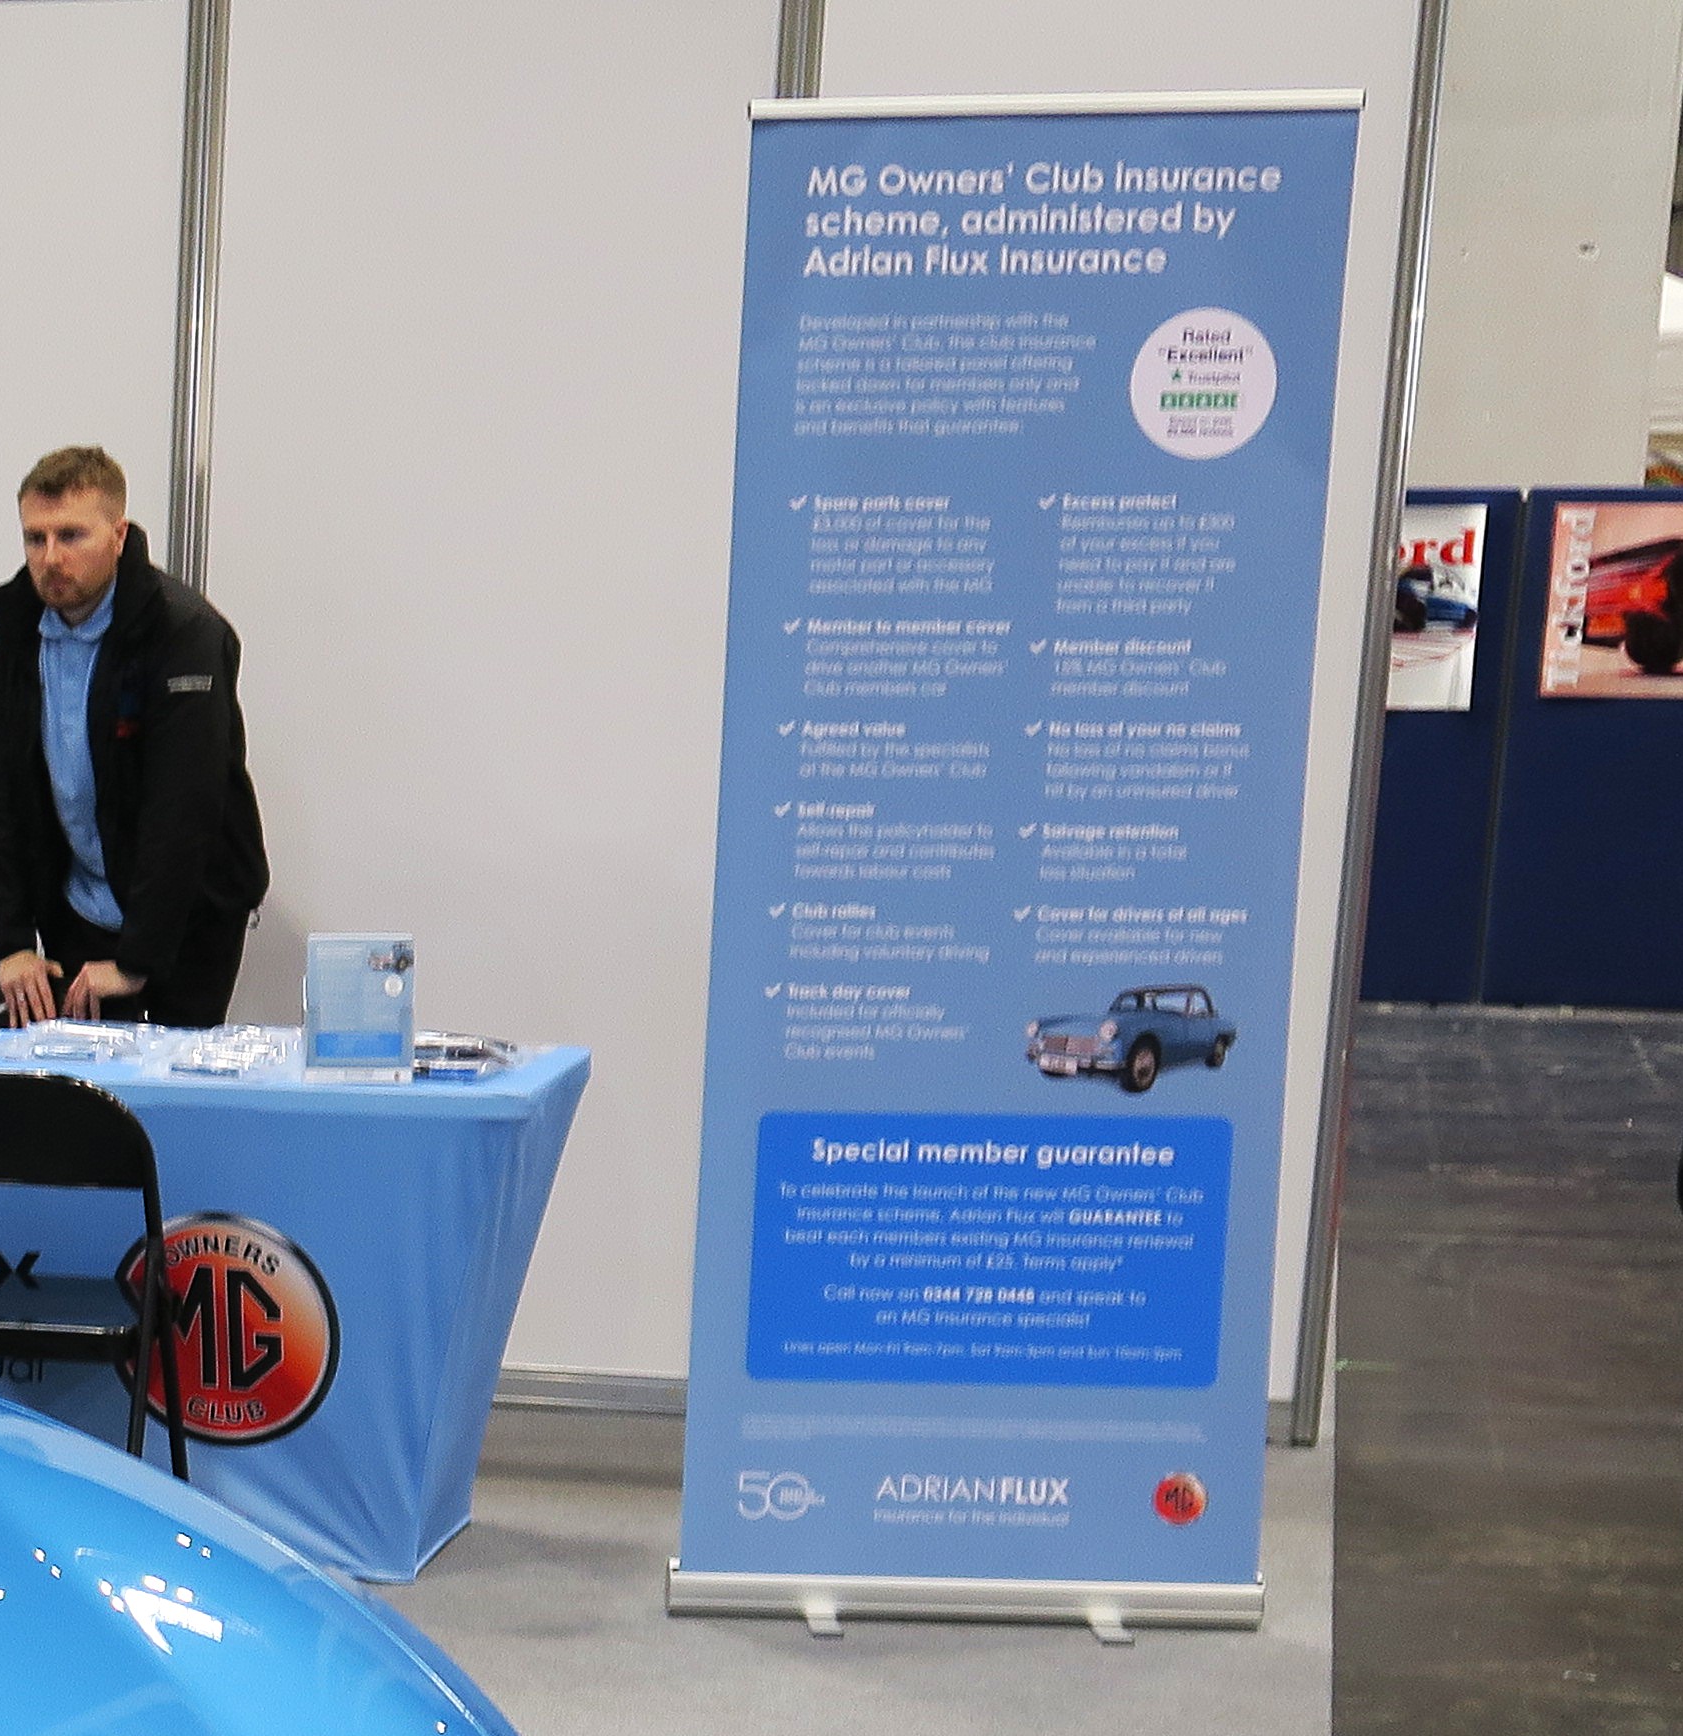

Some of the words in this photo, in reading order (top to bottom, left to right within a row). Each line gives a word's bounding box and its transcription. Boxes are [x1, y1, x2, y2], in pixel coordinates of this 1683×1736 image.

[808, 166, 867, 197] MG
[879, 161, 1013, 196] Owners'
[1026, 162, 1103, 194] Club
[806, 205, 949, 239] scheme,
[962, 203, 1182, 235] administered
[1193, 201, 1234, 240] by
[804, 244, 912, 277] Adrian
[925, 245, 988, 275] Flux
[1000, 243, 1166, 275] Insurance
[1183, 328, 1231, 346] Rated
[862, 496, 900, 512] parts
[904, 497, 949, 512] cover
[1063, 495, 1115, 511] Excess
[1118, 495, 1176, 510] protect
[807, 619, 871, 635] Member
[895, 620, 961, 635] member
[966, 620, 1010, 635] cover
[1054, 640, 1119, 655] Member
[1124, 640, 1191, 655] discount
[792, 903, 828, 919] Club
[813, 1137, 909, 1166] Special
[917, 1139, 1028, 1164] member
[1036, 1142, 1173, 1169] guarantee
[1067, 1209, 1162, 1226] GUARANTEE
[165, 1233, 282, 1278] OWNERS
[173, 1263, 284, 1392] MG
[186, 1393, 267, 1425] CLUB
